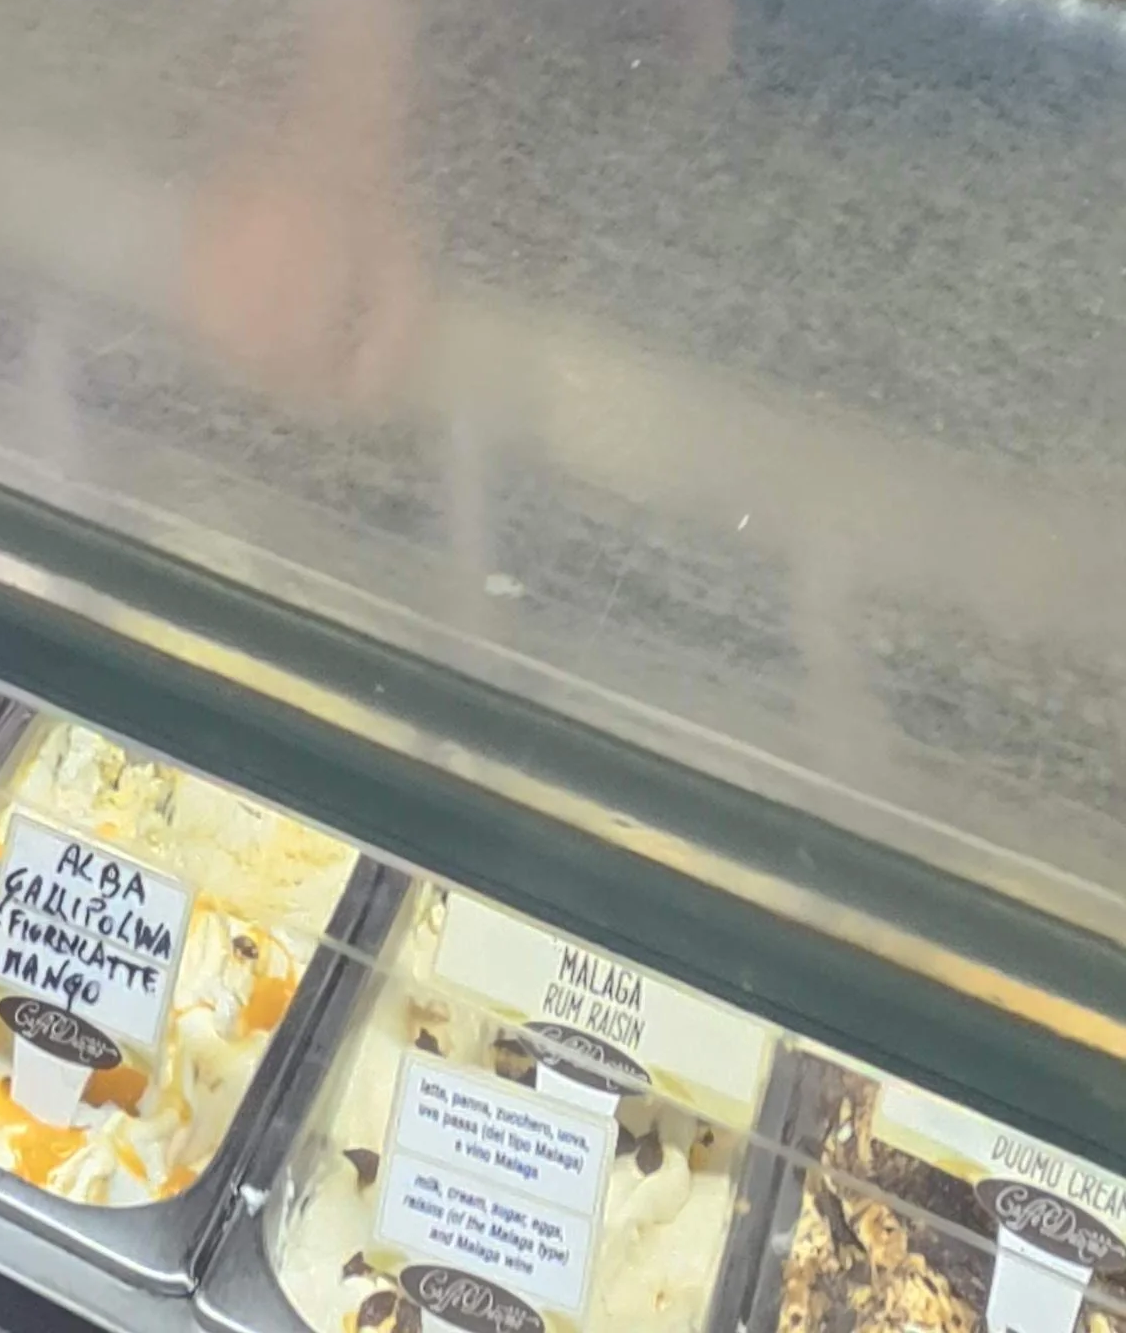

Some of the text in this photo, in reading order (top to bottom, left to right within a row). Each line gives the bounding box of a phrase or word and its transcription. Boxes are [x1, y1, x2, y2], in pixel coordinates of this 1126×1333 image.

[56, 843, 146, 905] ALBA
[558, 944, 642, 1012] MALAGA
[542, 982, 646, 1051] RUM RAISIN
[494, 1150, 539, 1181] Malaga
[991, 1136, 1063, 1189] DUOMO
[454, 1234, 501, 1264] Malaga
[489, 1223, 535, 1253] Malaga
